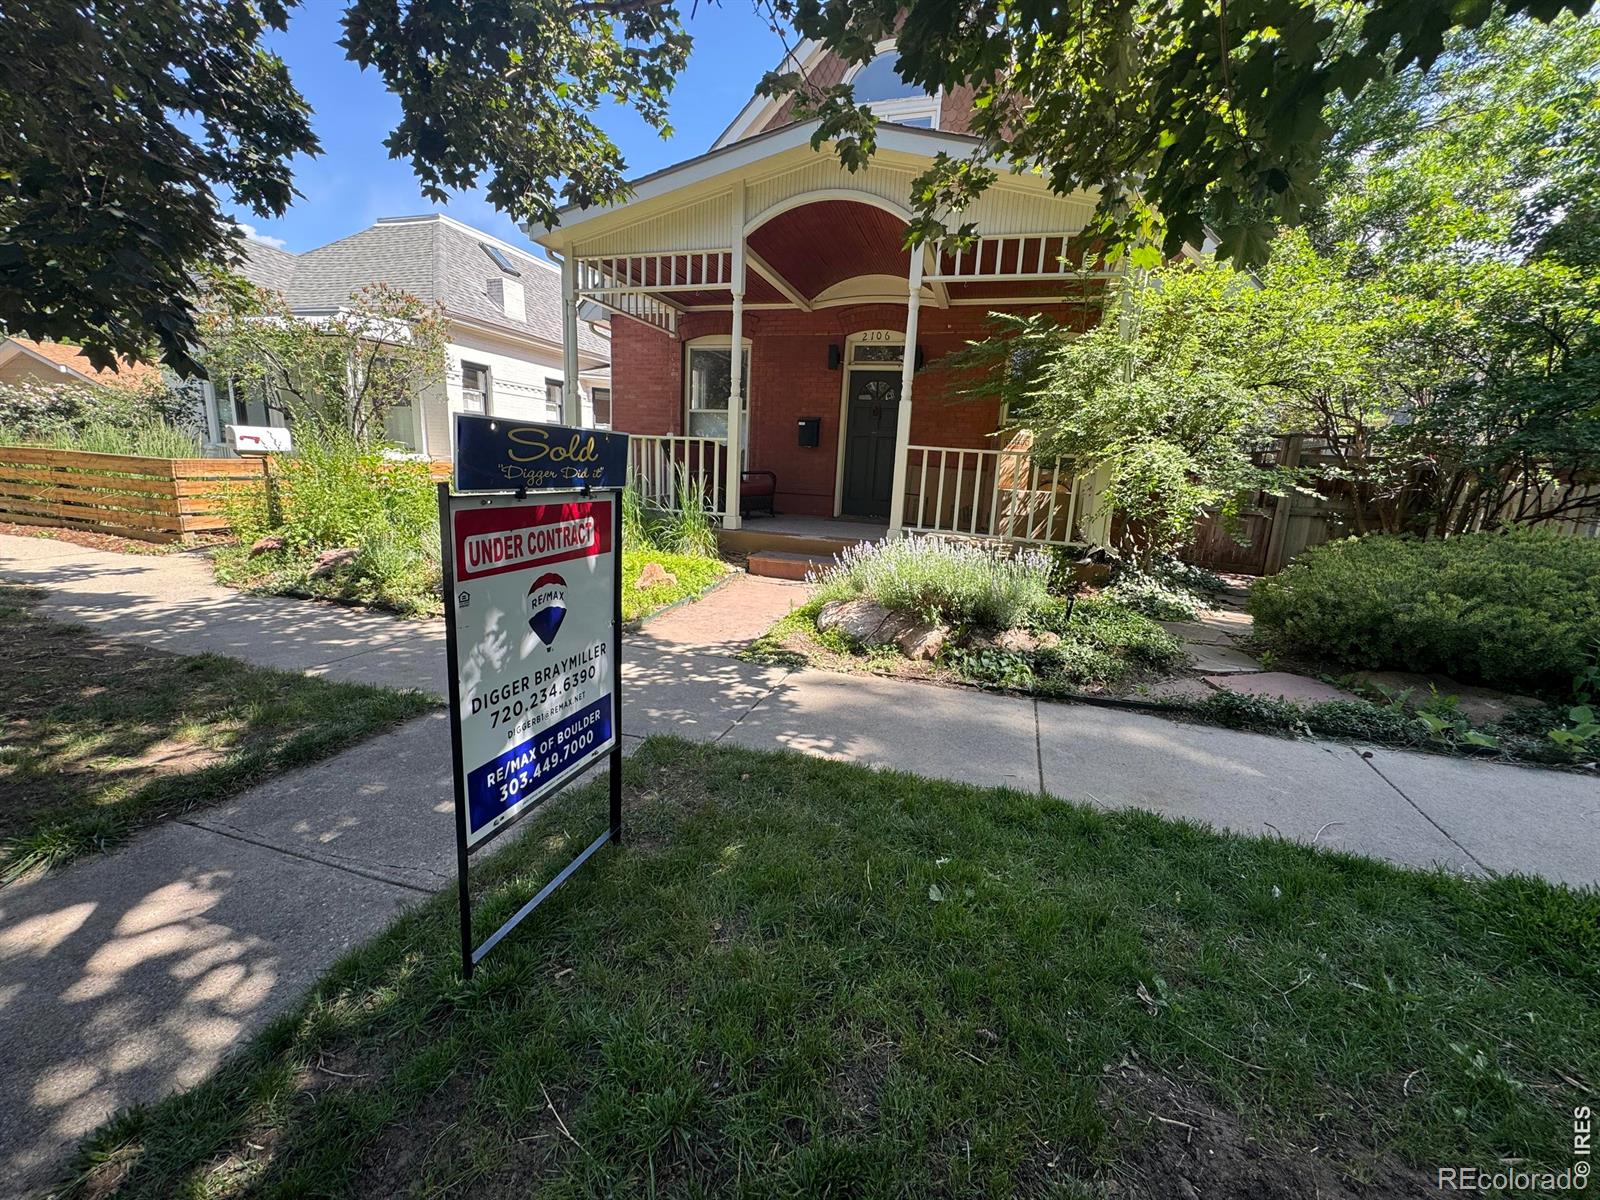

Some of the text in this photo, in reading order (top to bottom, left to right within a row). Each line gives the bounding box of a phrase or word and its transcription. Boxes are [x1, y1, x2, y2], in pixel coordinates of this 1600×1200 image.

[862, 331, 890, 341] 2106
[508, 427, 599, 462] Sold
[498, 463, 558, 486] "Digger
[561, 466, 589, 479] Did
[468, 522, 592, 567] UNDER CONTRACT
[531, 591, 565, 610] RE/MAX
[472, 642, 607, 715] DIGGER BRAYMILLER
[490, 665, 596, 729] 720.234.6390
[507, 691, 586, 739] DIGGERB1@REMAX.NET
[487, 747, 537, 788] RE/MAX
[539, 736, 554, 754] OF
[557, 709, 601, 744] BOULDER
[499, 730, 594, 802] 303.449.7000
